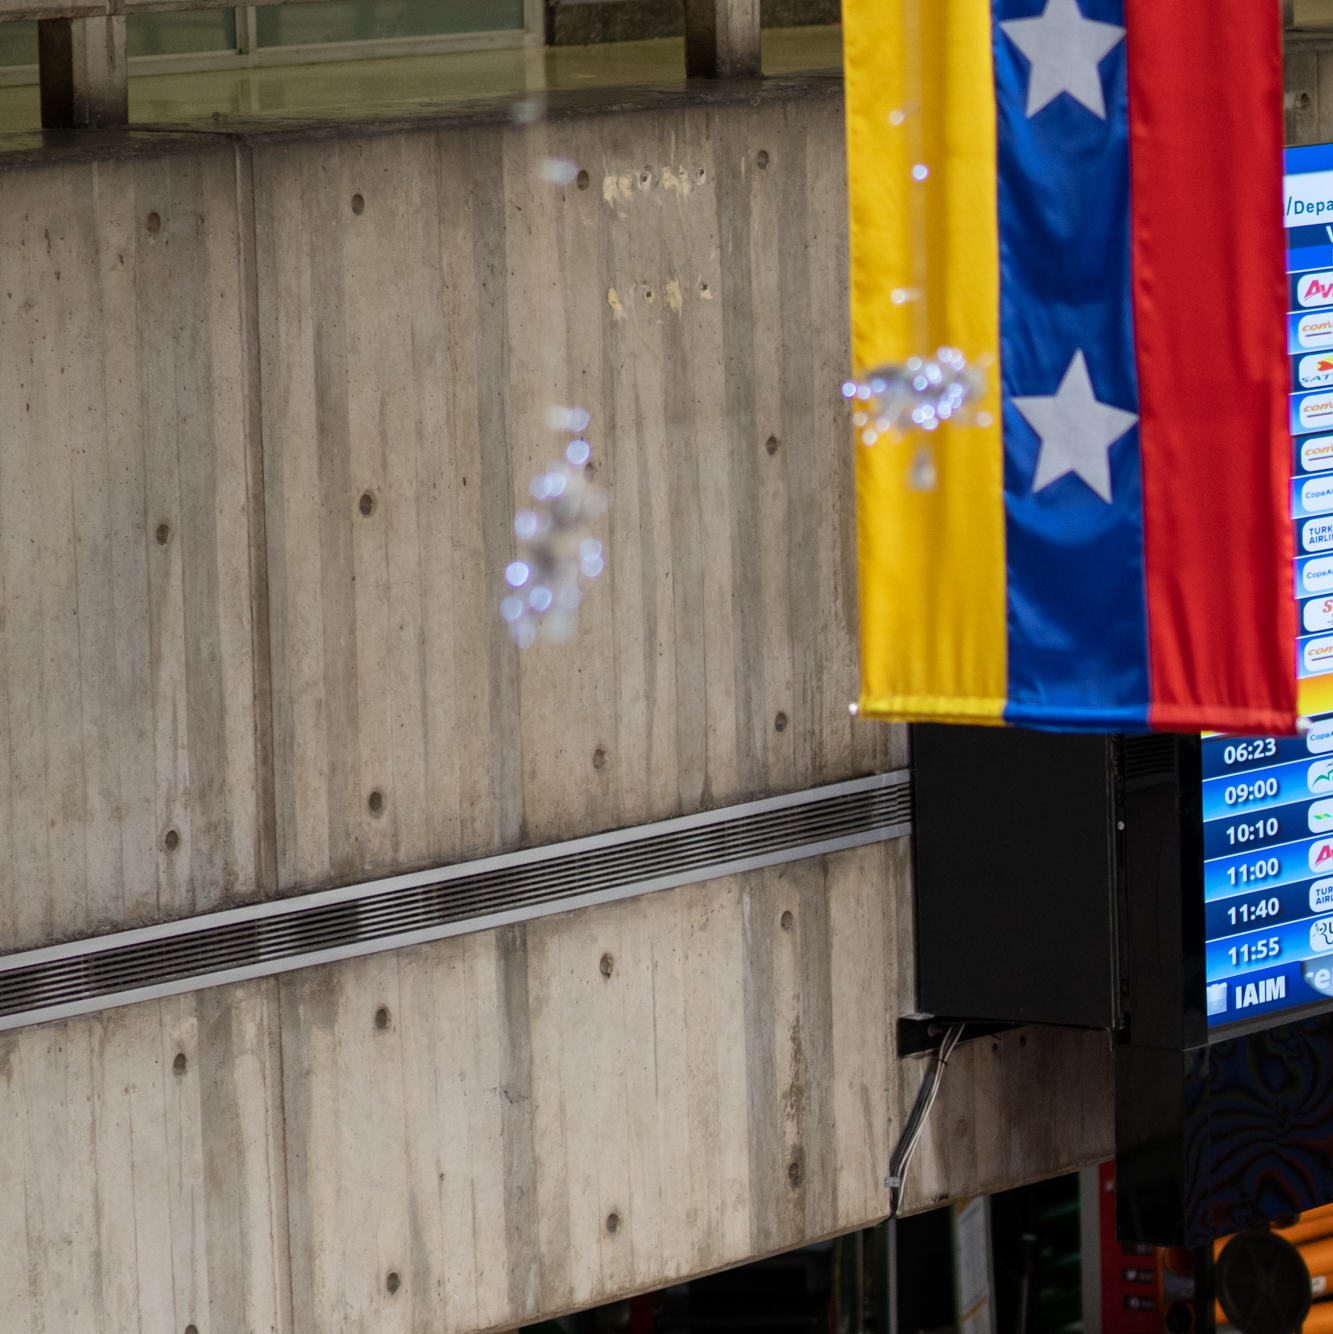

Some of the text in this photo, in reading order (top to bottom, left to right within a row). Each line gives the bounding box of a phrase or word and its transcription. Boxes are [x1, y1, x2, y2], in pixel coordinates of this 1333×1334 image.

[1224, 738, 1277, 764] 06:23
[1225, 778, 1277, 804] 09:00
[1227, 818, 1278, 844] 10:10
[1227, 858, 1278, 884] 11:00
[1228, 898, 1279, 924] 11:40
[1228, 937, 1279, 964] 11:55
[1236, 976, 1285, 1008] IAIM
